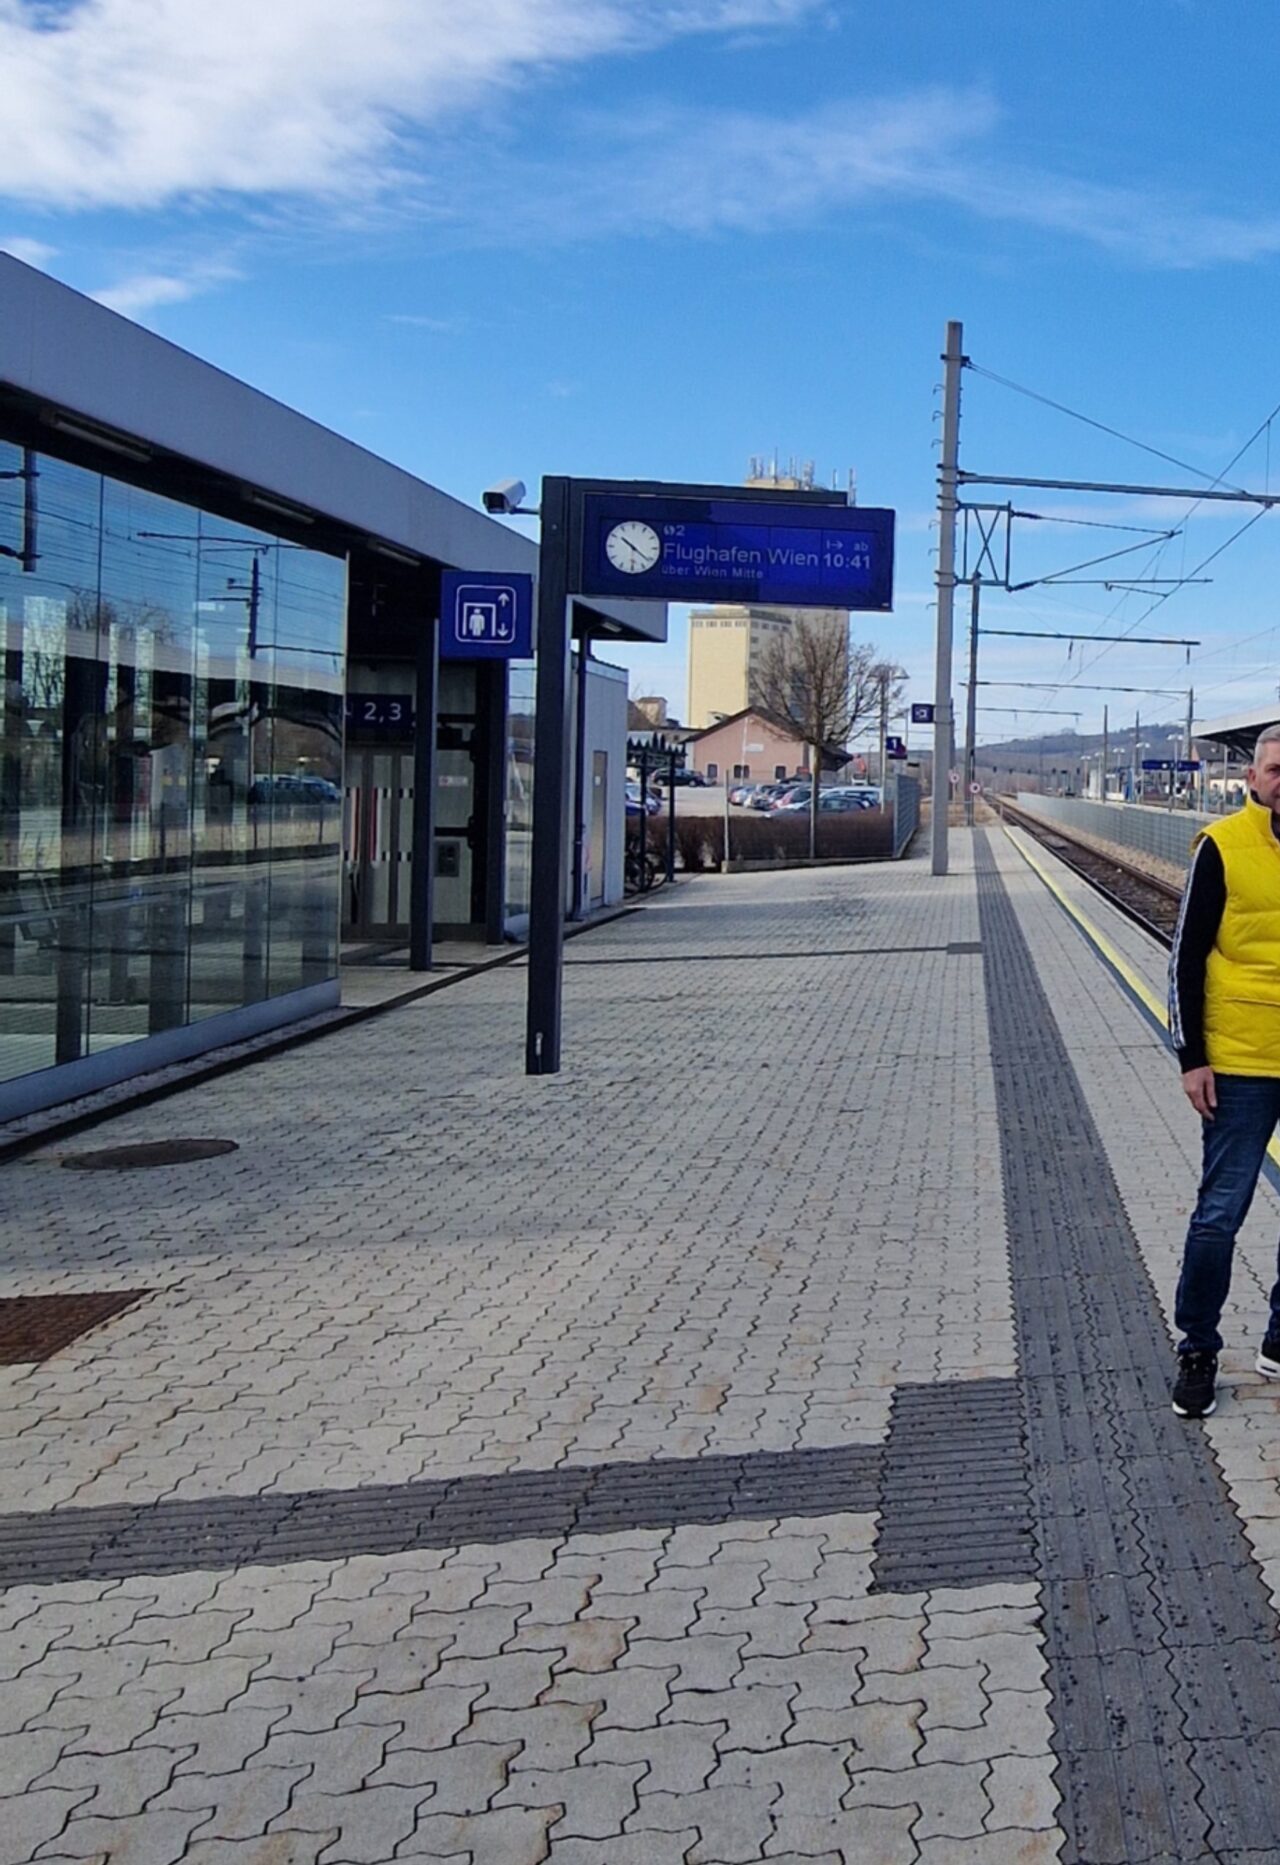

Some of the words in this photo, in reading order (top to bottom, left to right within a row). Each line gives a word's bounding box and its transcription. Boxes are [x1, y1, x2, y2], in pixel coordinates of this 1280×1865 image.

[854, 541, 869, 551] ab
[663, 542, 761, 564] Flughafen
[767, 547, 818, 566] Wien
[823, 552, 870, 569] 10:41
[694, 565, 727, 577] Wien
[732, 567, 763, 578] Mitte
